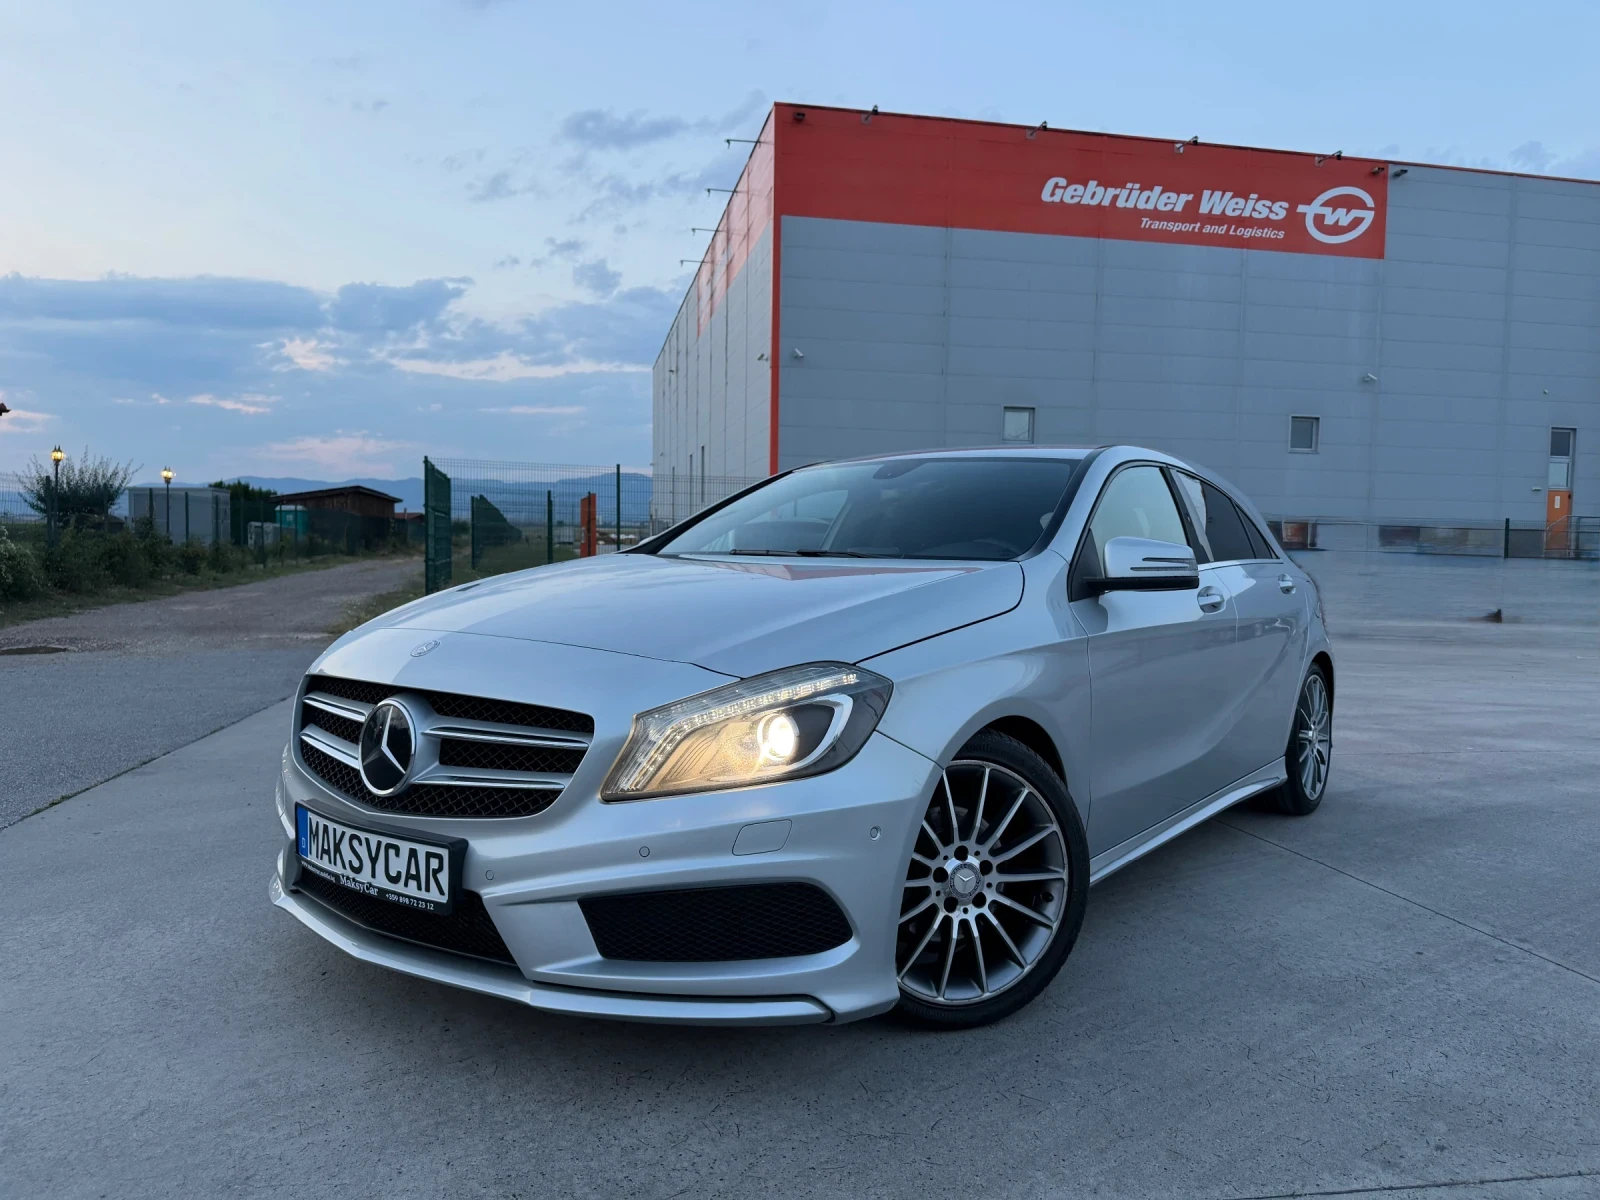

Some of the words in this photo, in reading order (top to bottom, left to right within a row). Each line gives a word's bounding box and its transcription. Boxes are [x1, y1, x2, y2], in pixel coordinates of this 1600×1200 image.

[1040, 176, 1193, 213] Gebrüder
[1199, 189, 1289, 221] Weiss
[1140, 217, 1201, 234] Transport
[1202, 222, 1227, 235] and
[1229, 224, 1285, 240] Logistics
[308, 815, 446, 897] MAKSYCAR
[339, 874, 379, 896] MaksyCar
[385, 893, 399, 902] +359
[410, 898, 418, 906] 72
[418, 900, 426, 908] 23
[427, 902, 434, 910] 12
